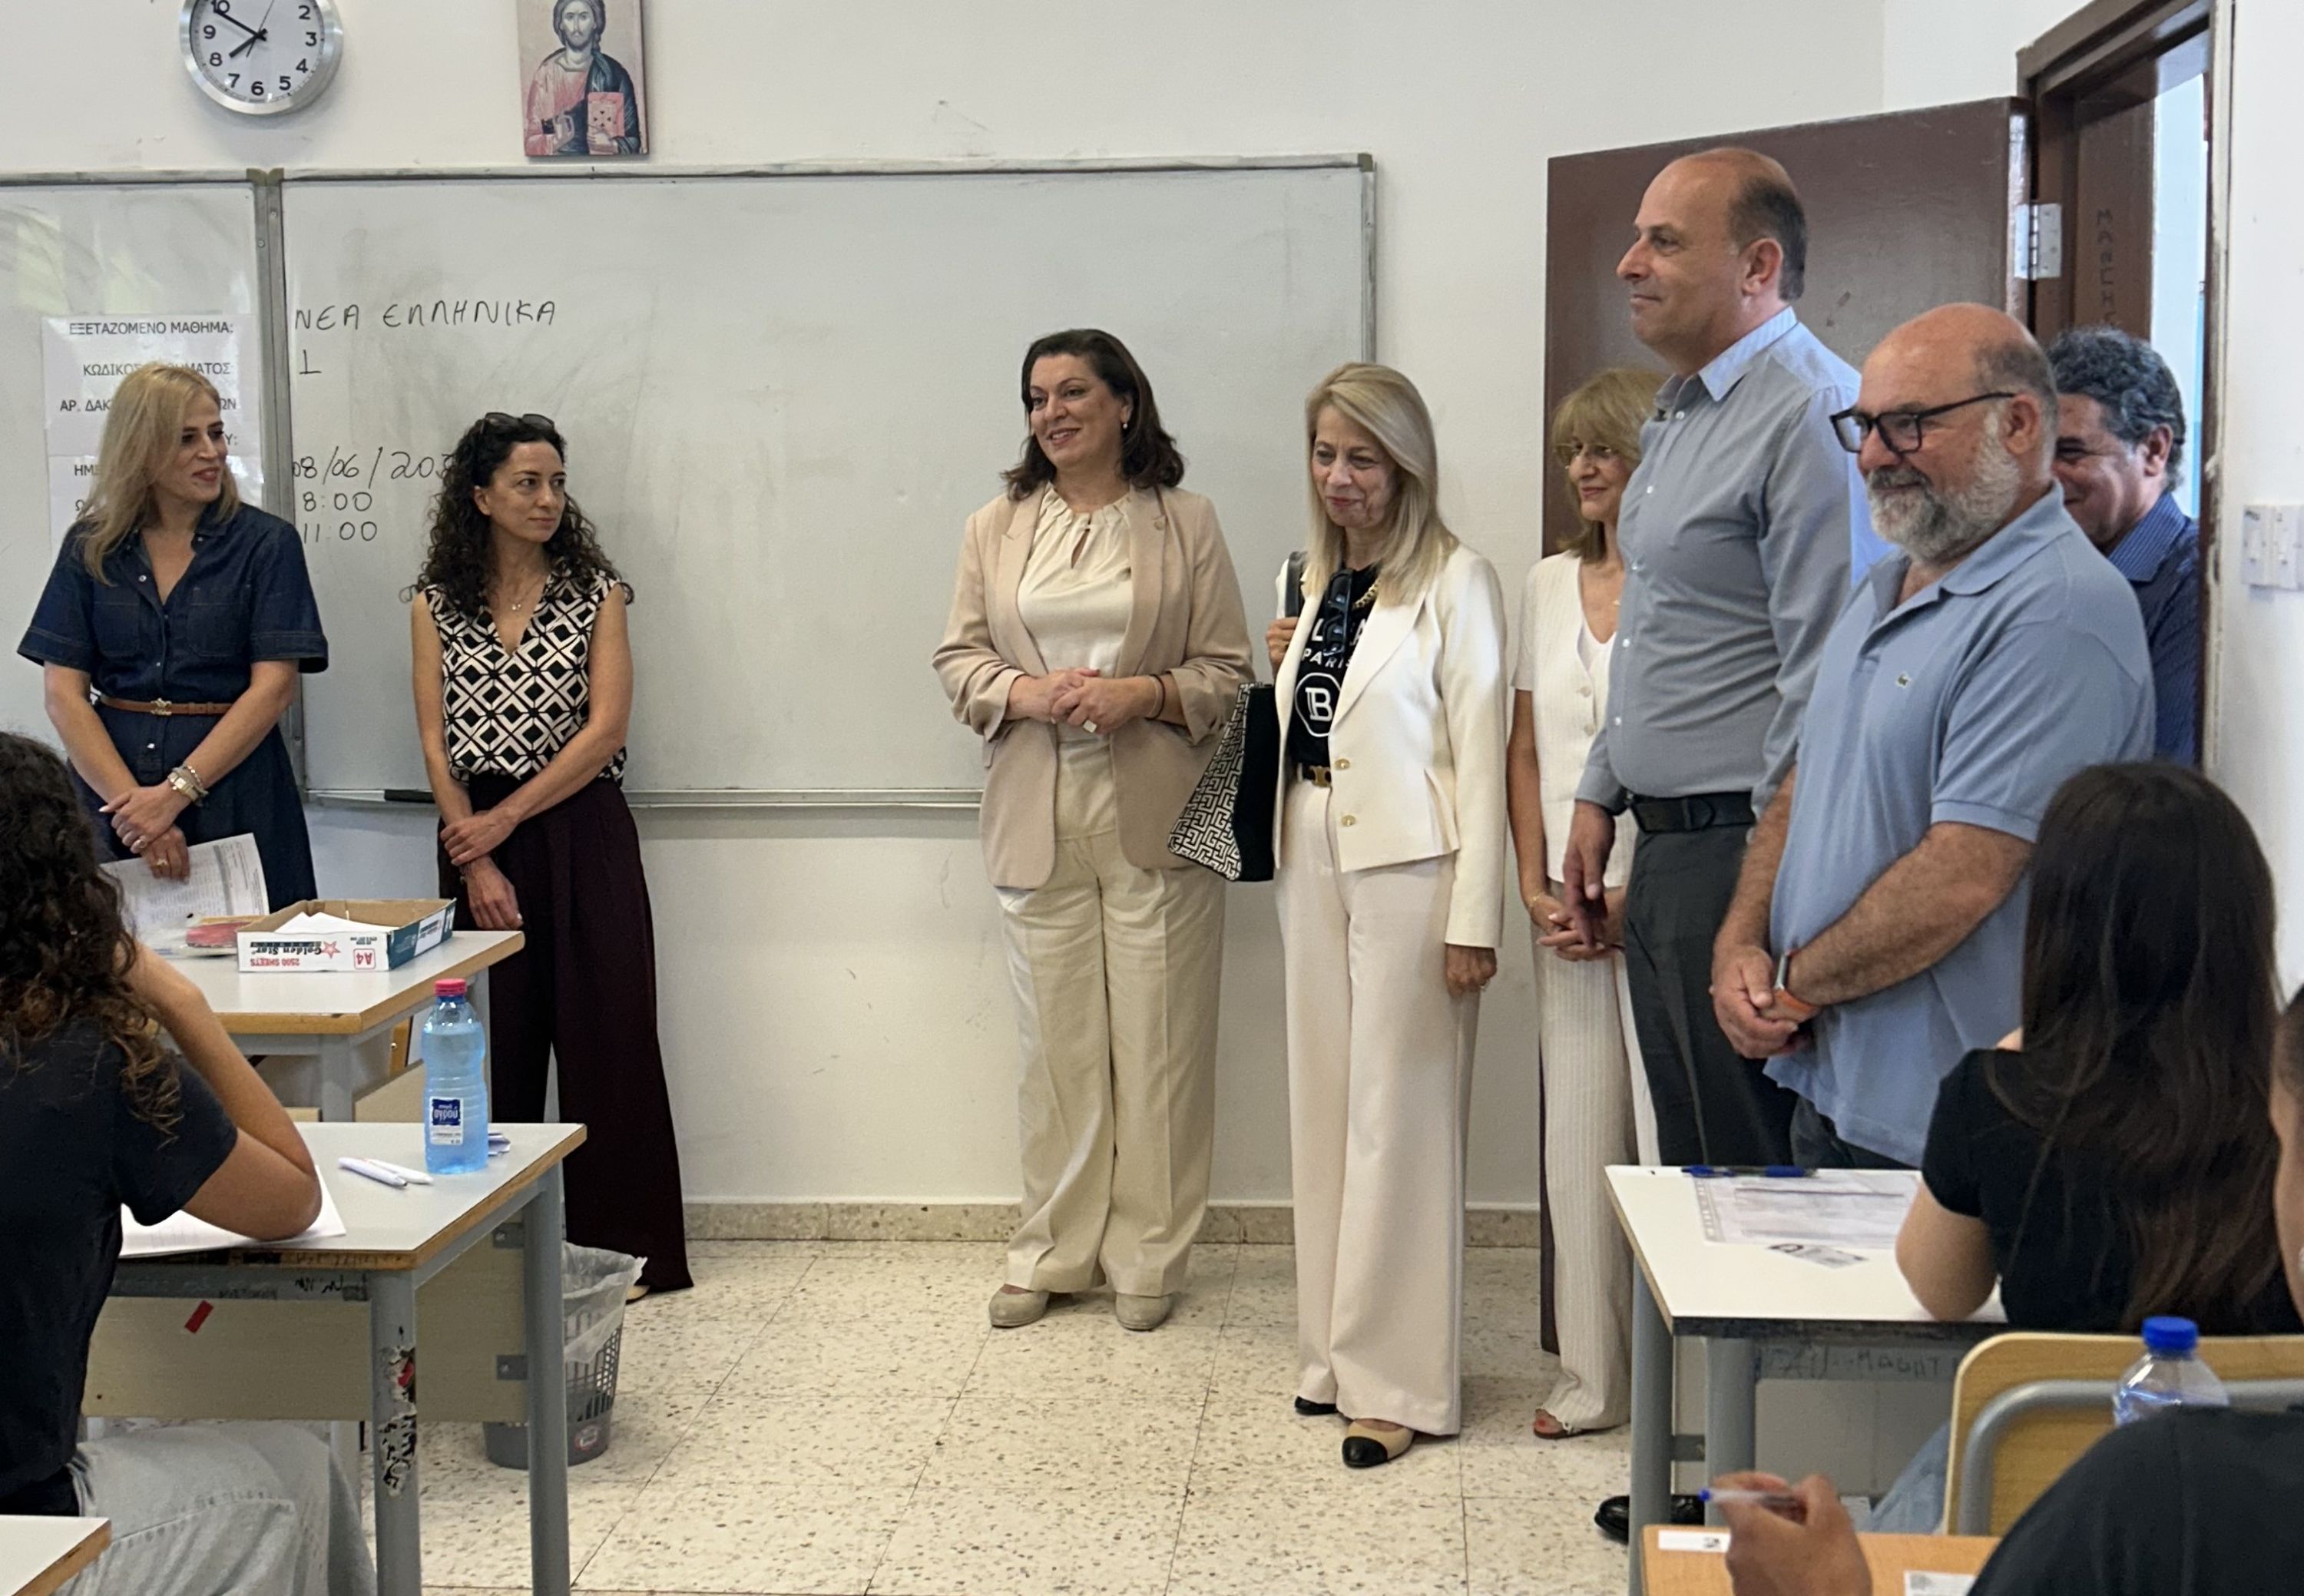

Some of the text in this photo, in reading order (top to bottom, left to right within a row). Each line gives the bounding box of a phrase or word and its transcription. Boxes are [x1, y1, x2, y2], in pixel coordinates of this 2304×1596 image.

[299, 5, 310, 19] 2
[204, 25, 216, 39] 9
[306, 31, 316, 46] 3
[210, 52, 223, 67] 8
[296, 58, 308, 74] 4
[228, 73, 240, 88] 7
[279, 76, 291, 91] 5
[251, 81, 264, 96] 6
[295, 304, 359, 330] ΝΕΑ
[69, 321, 233, 335] ΕΞΕΤΑΖΟΜΕΝΟ ΜΑΘΗΜΑ:
[60, 399, 81, 412] ΑΡ.
[356, 952, 373, 965] A4
